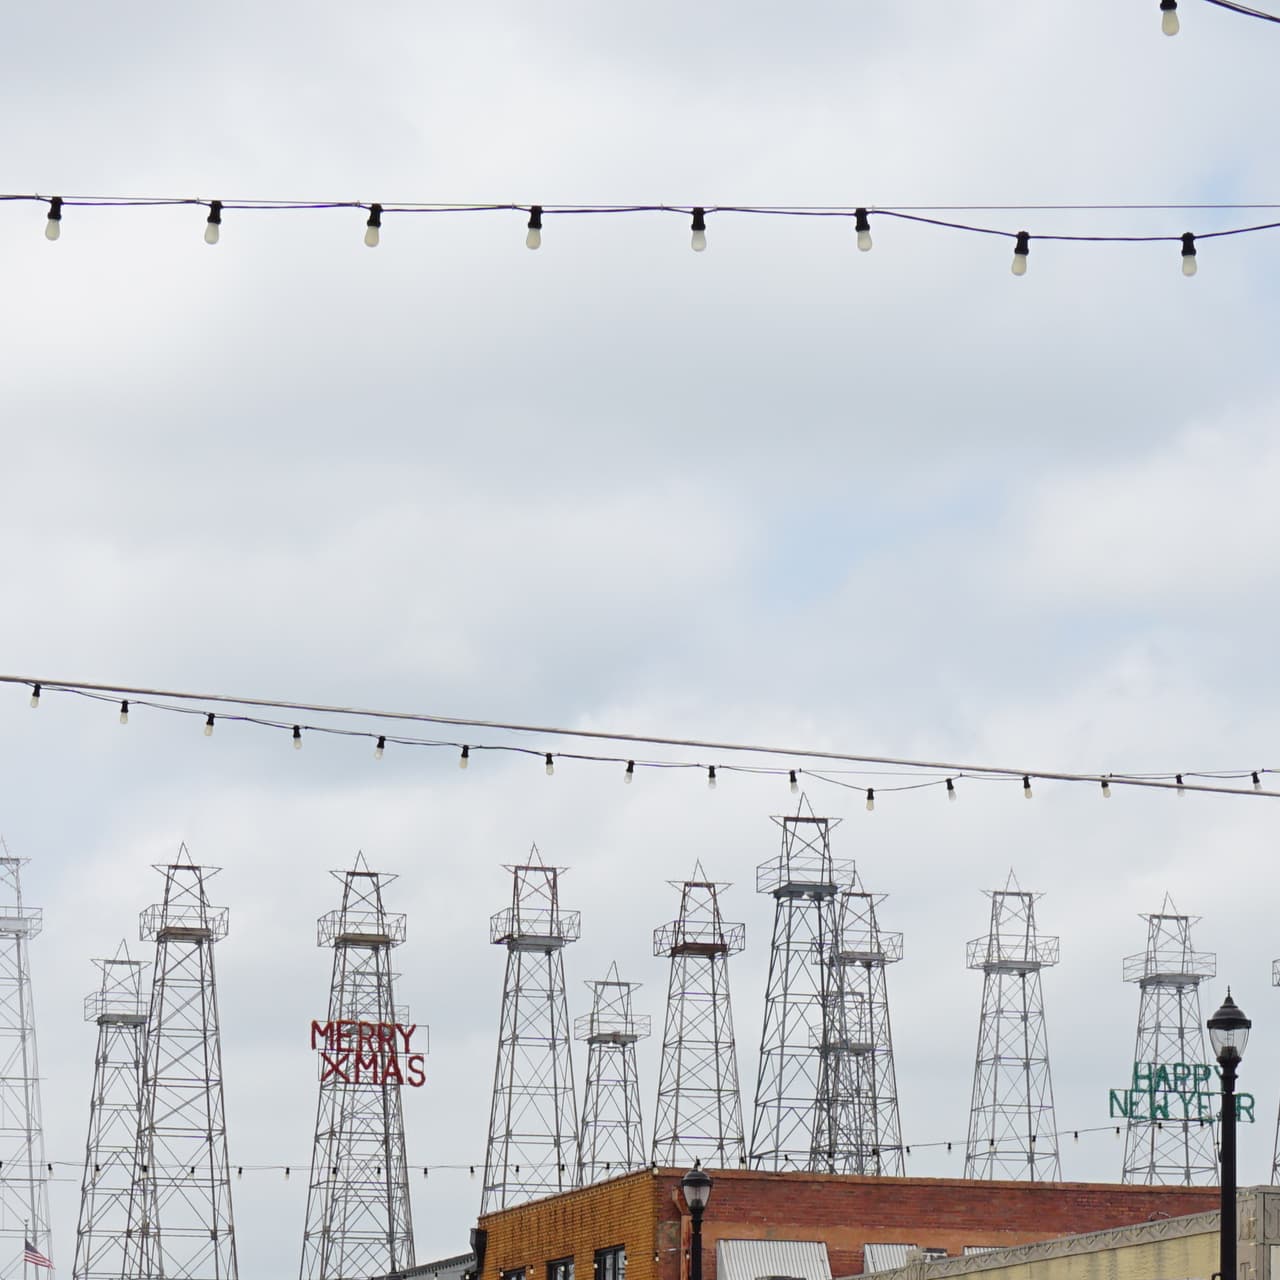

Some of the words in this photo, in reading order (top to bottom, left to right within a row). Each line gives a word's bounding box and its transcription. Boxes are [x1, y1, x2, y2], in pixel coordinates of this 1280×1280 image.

[311, 1020, 417, 1054] MERRY
[321, 1050, 426, 1087] XMAS
[1109, 1088, 1169, 1120] NEW
[1179, 1091, 1256, 1124] YER
